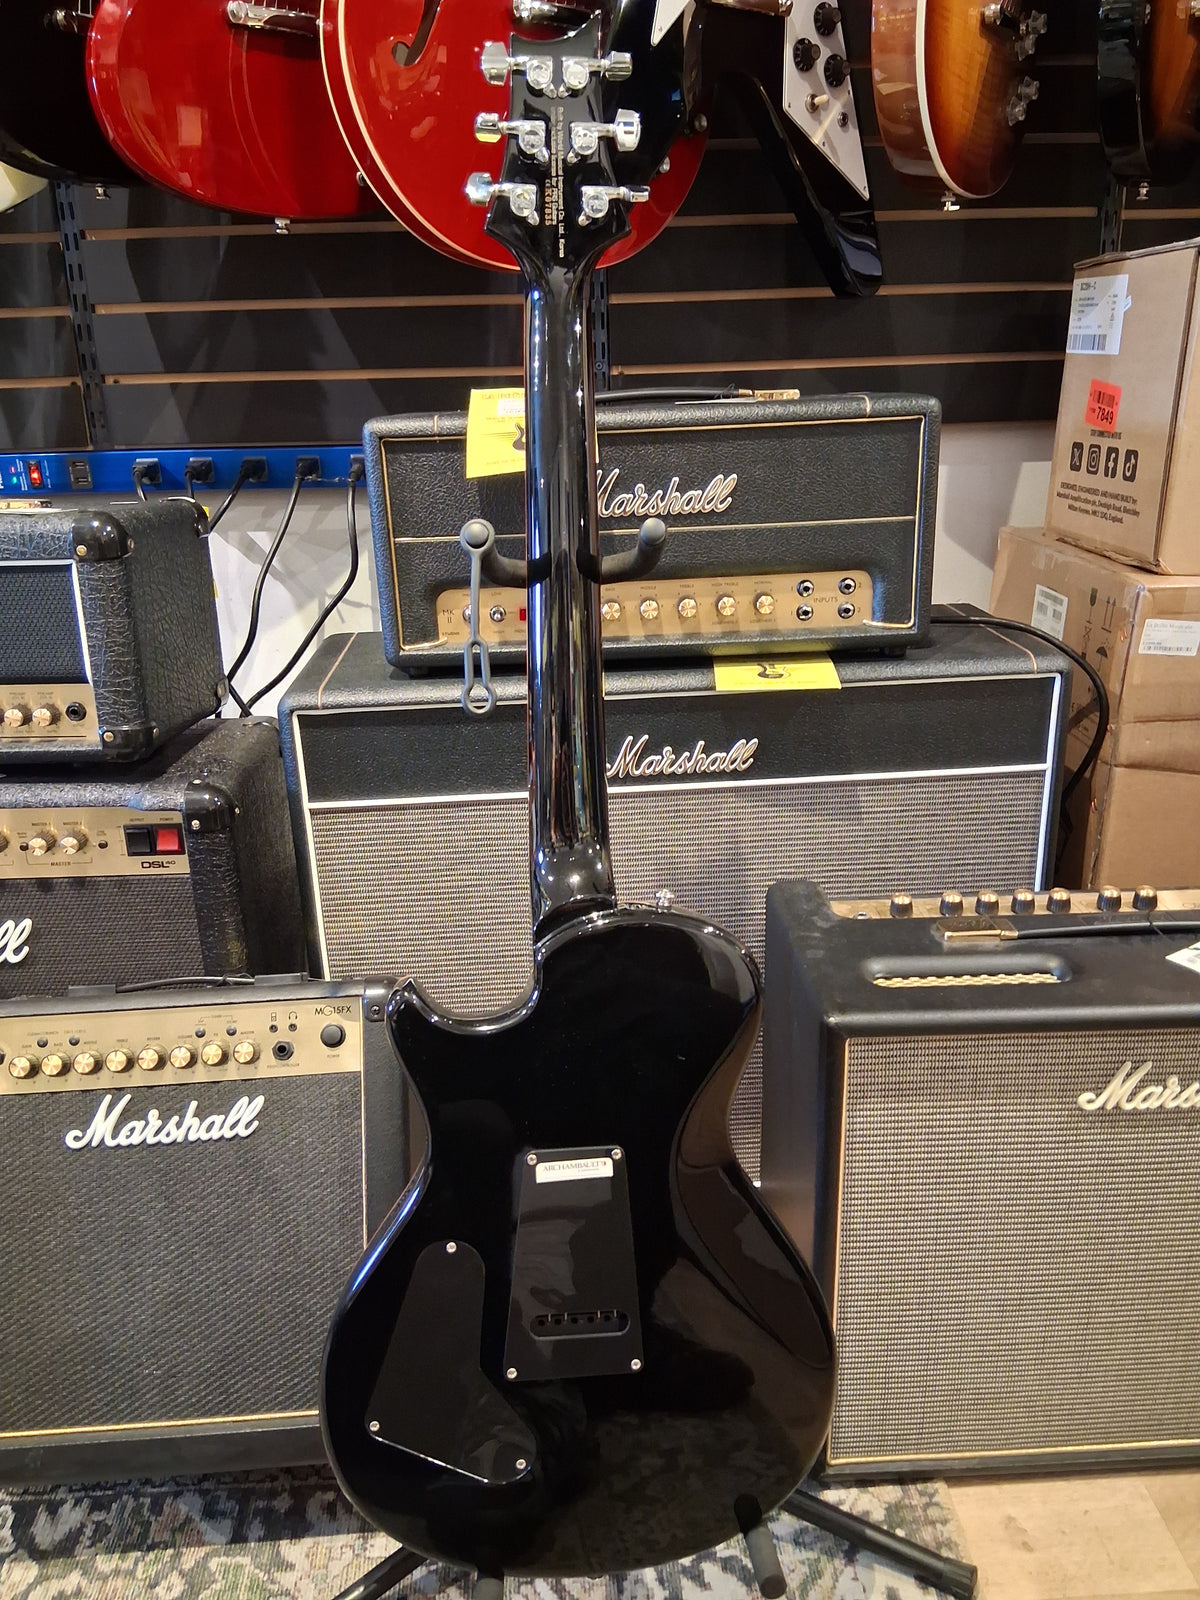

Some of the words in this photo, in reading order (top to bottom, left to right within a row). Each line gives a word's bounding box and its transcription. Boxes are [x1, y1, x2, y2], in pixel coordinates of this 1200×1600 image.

[1096, 406, 1114, 425] 7849
[606, 734, 759, 779] Marshall
[314, 1005, 352, 1016] MG15FX
[65, 1094, 265, 1150] Marshall
